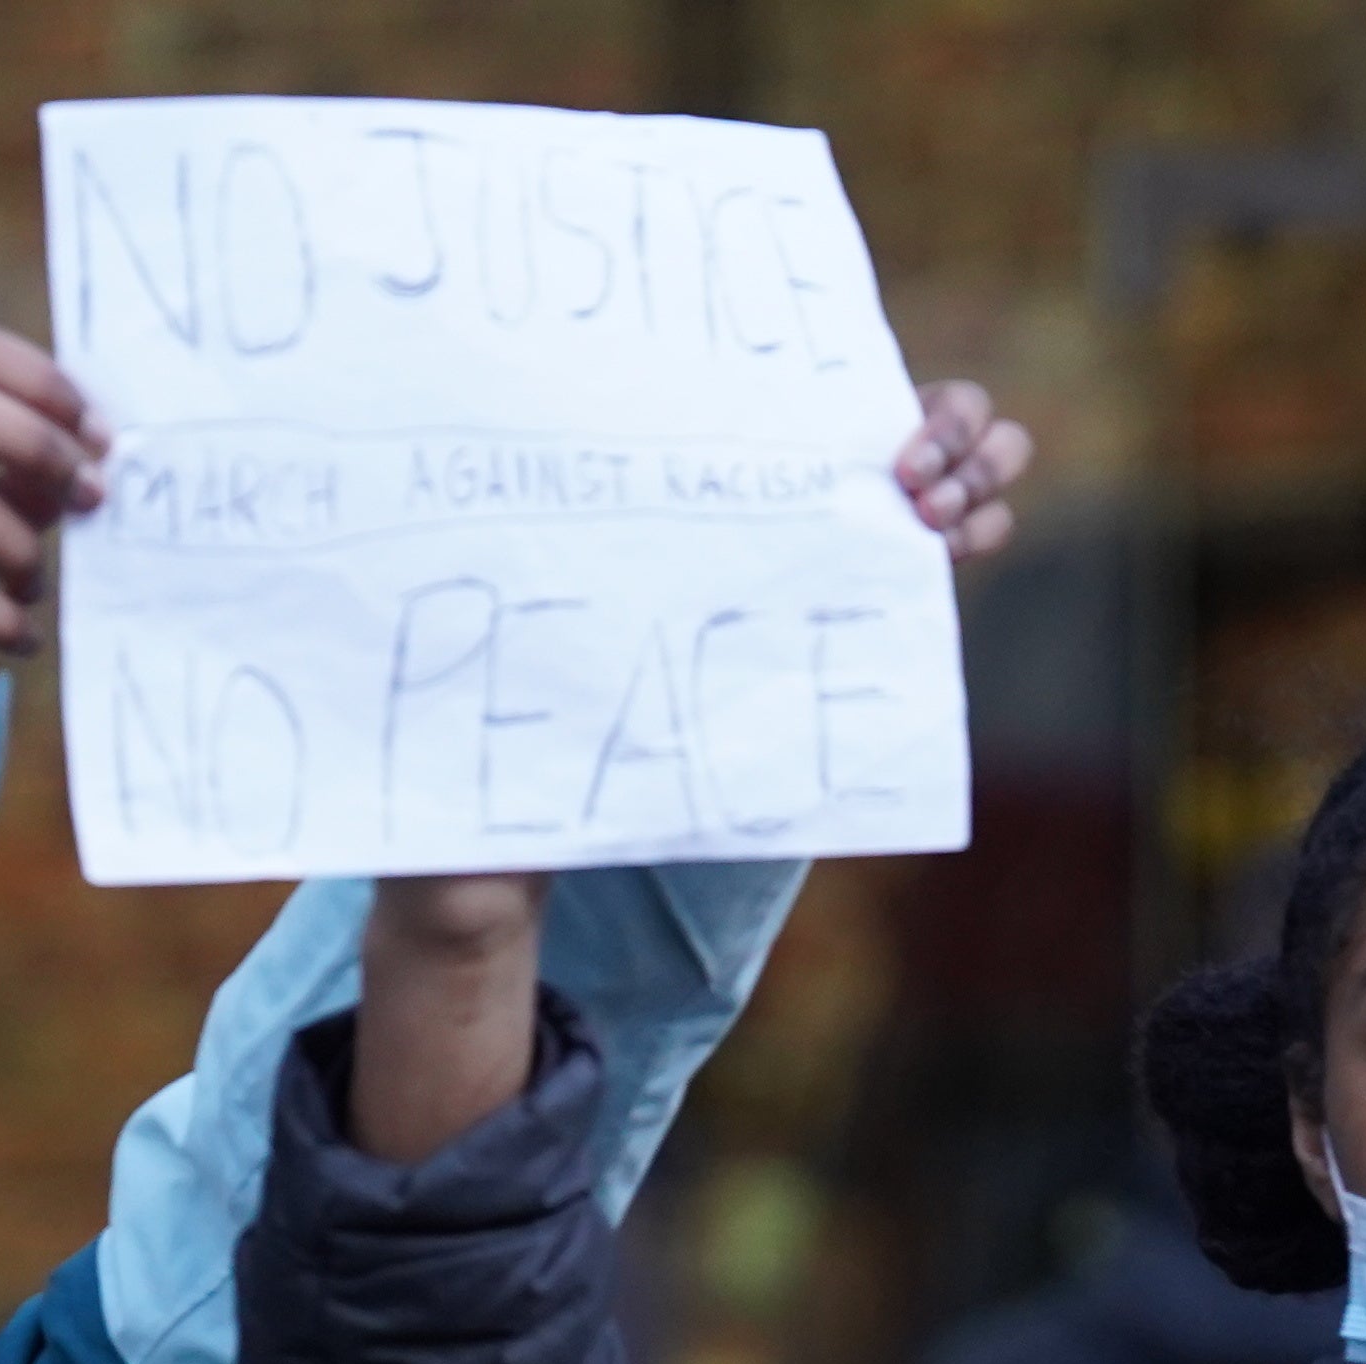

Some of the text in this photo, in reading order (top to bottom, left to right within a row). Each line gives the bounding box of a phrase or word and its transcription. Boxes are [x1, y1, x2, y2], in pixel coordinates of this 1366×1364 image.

[75, 128, 849, 372] NO JUSTICE
[109, 446, 837, 544] MARCH AGAINST RACISM
[111, 575, 908, 851] NO PEACE
